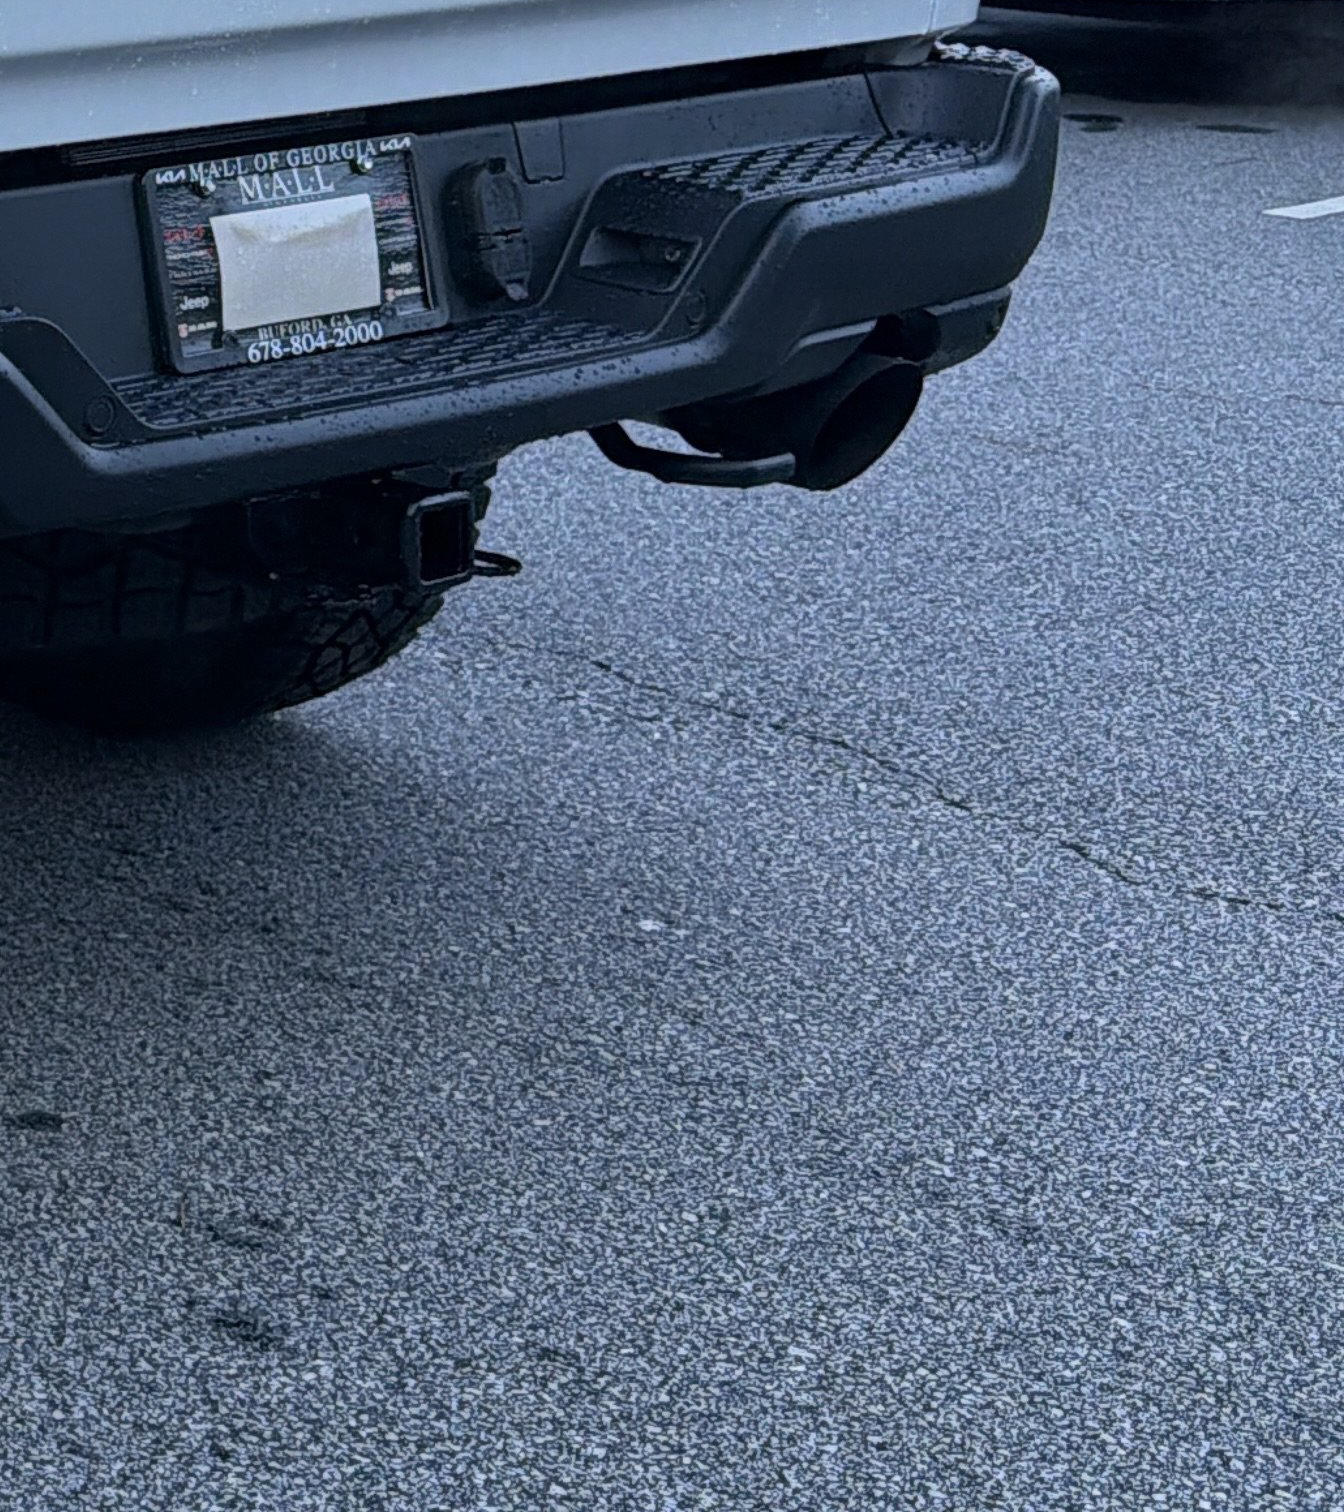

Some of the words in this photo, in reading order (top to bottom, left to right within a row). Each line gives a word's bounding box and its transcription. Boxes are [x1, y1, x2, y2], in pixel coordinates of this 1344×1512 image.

[253, 151, 280, 173] OF
[286, 139, 377, 168] GEORGIA
[179, 296, 210, 311] Jeep
[248, 320, 384, 364] 678-804-2000
